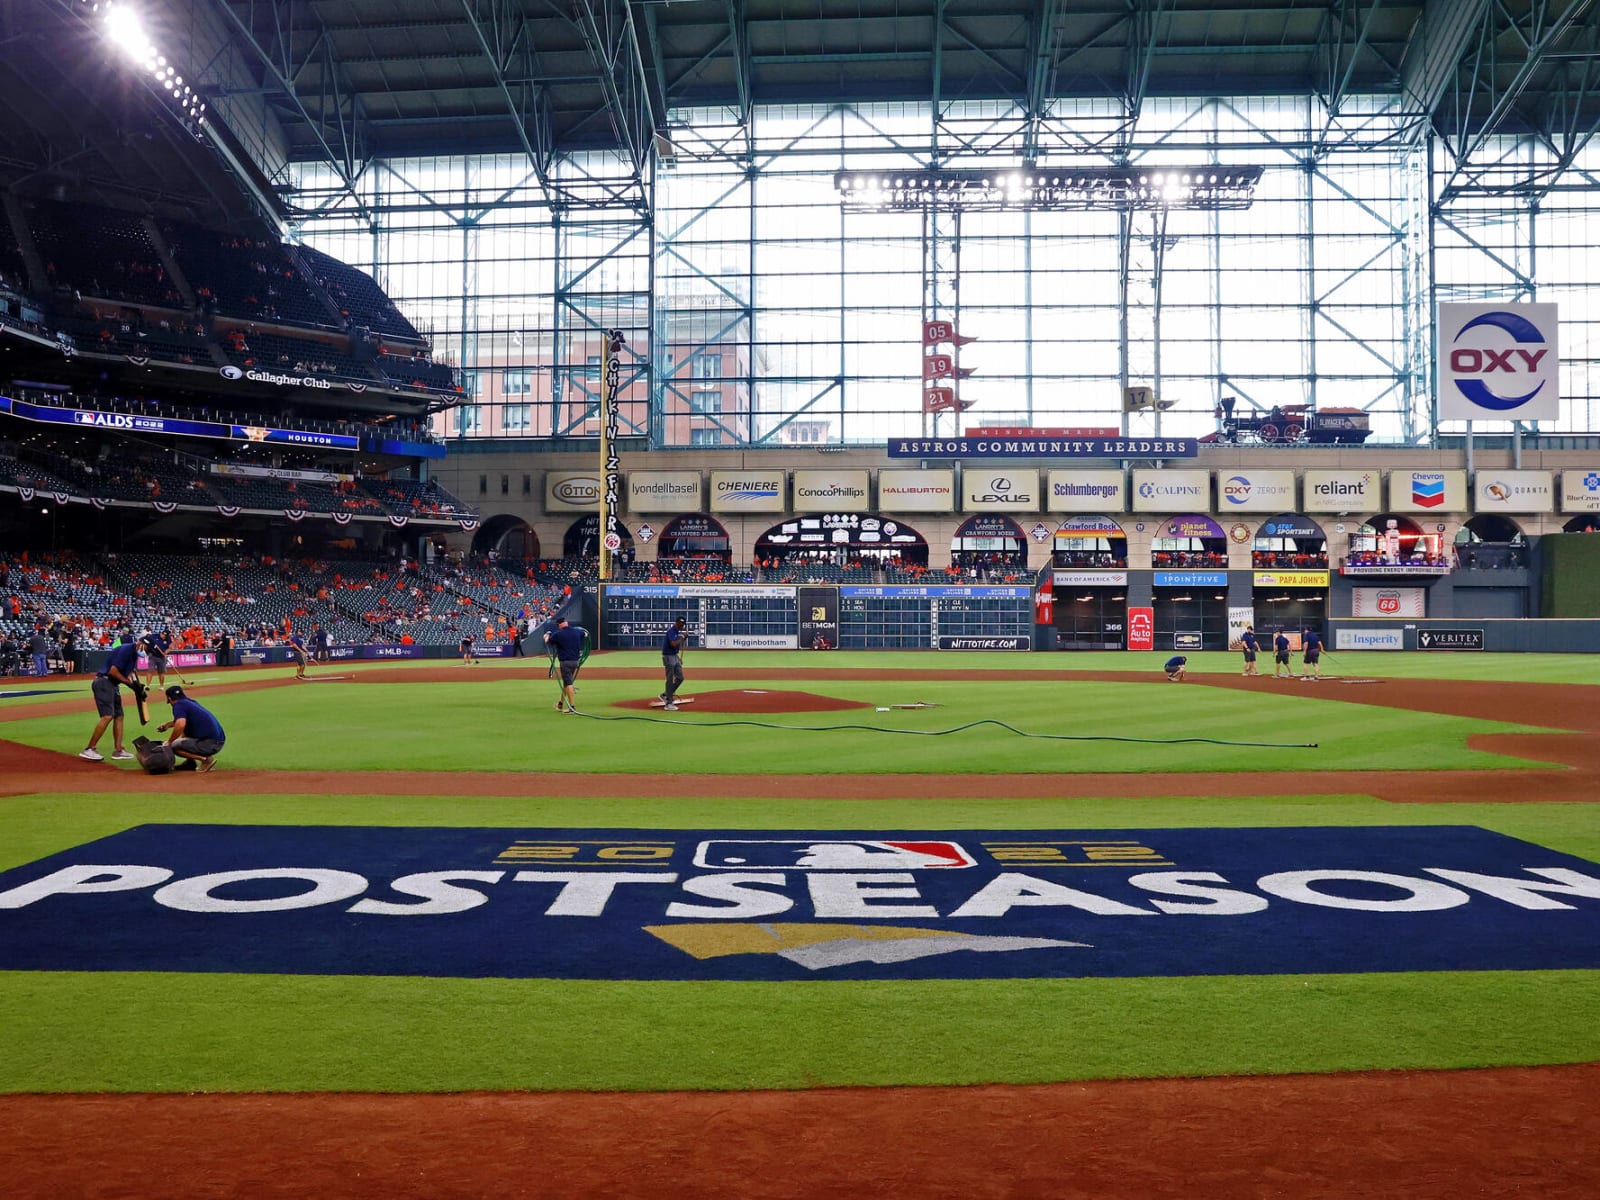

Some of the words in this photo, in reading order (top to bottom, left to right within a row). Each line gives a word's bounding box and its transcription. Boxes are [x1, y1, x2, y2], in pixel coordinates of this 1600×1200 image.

[929, 326, 946, 339] 05
[930, 360, 946, 373] 19
[1450, 349, 1548, 373] OXY
[246, 370, 301, 385] Gallagher
[303, 378, 330, 389] Club
[929, 392, 944, 405] 21
[1130, 391, 1146, 405] 17
[96, 414, 134, 428] ALDS
[288, 434, 332, 444] HOUSTON
[900, 442, 970, 452] ASTROS
[978, 442, 1095, 452] COMMUNITY
[1104, 442, 1186, 452] LEADERS
[632, 482, 698, 496] lyondellbasell
[718, 481, 778, 491] CHENIERE
[799, 486, 864, 498] ConocoPhillips
[1054, 484, 1118, 498] Schlumberger
[1314, 481, 1364, 495] reliant
[607, 475, 618, 530] FAIR
[1180, 523, 1207, 531] planet
[1279, 576, 1294, 584] PAPA
[1298, 576, 1325, 584] JOHN'S
[952, 640, 1017, 648] NITTOTIRE.COM
[1354, 634, 1399, 644] Insperity
[0, 864, 1600, 918] POSTSEASON
